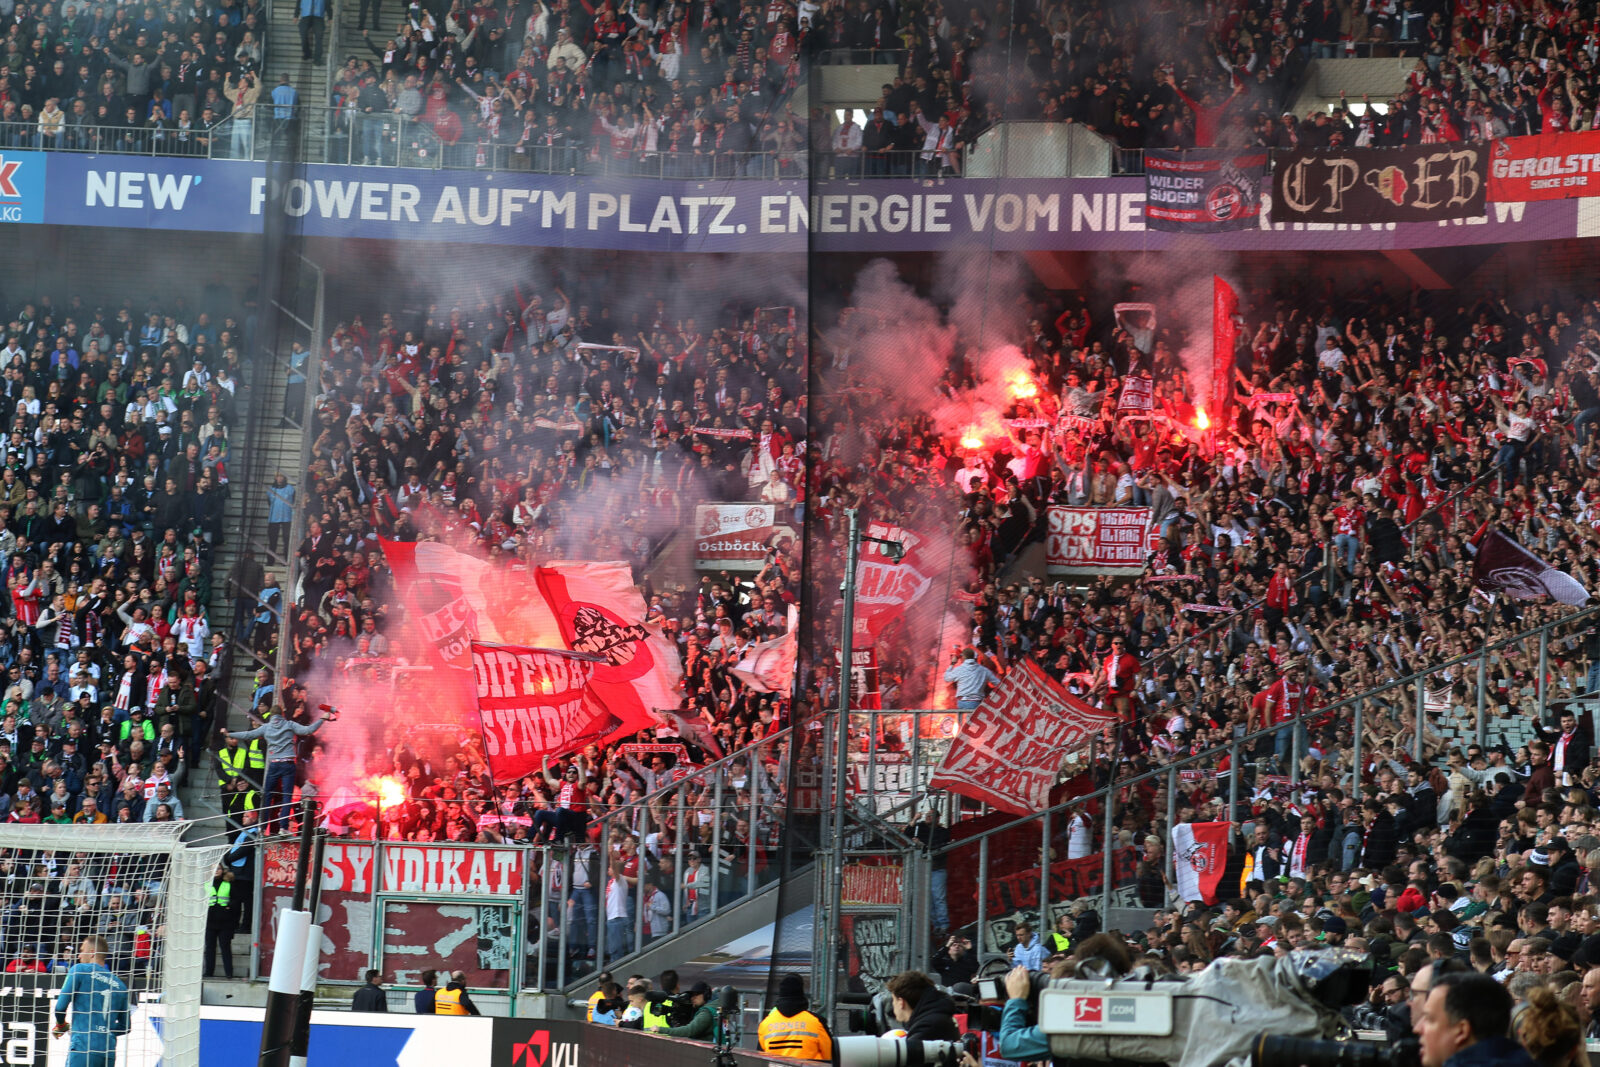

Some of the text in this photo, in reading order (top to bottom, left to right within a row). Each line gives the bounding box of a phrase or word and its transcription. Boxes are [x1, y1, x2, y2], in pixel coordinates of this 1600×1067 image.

[1149, 174, 1205, 190] WILDER
[1529, 177, 1562, 190] SINCE
[1149, 187, 1200, 204] SÜDEN
[587, 193, 747, 235] PLATZ.
[760, 194, 953, 234] ENERGIE
[963, 193, 1060, 232] VOM
[1047, 509, 1098, 535] SPS
[1047, 533, 1097, 560] CGN
[987, 678, 1086, 748] SEKTIO
